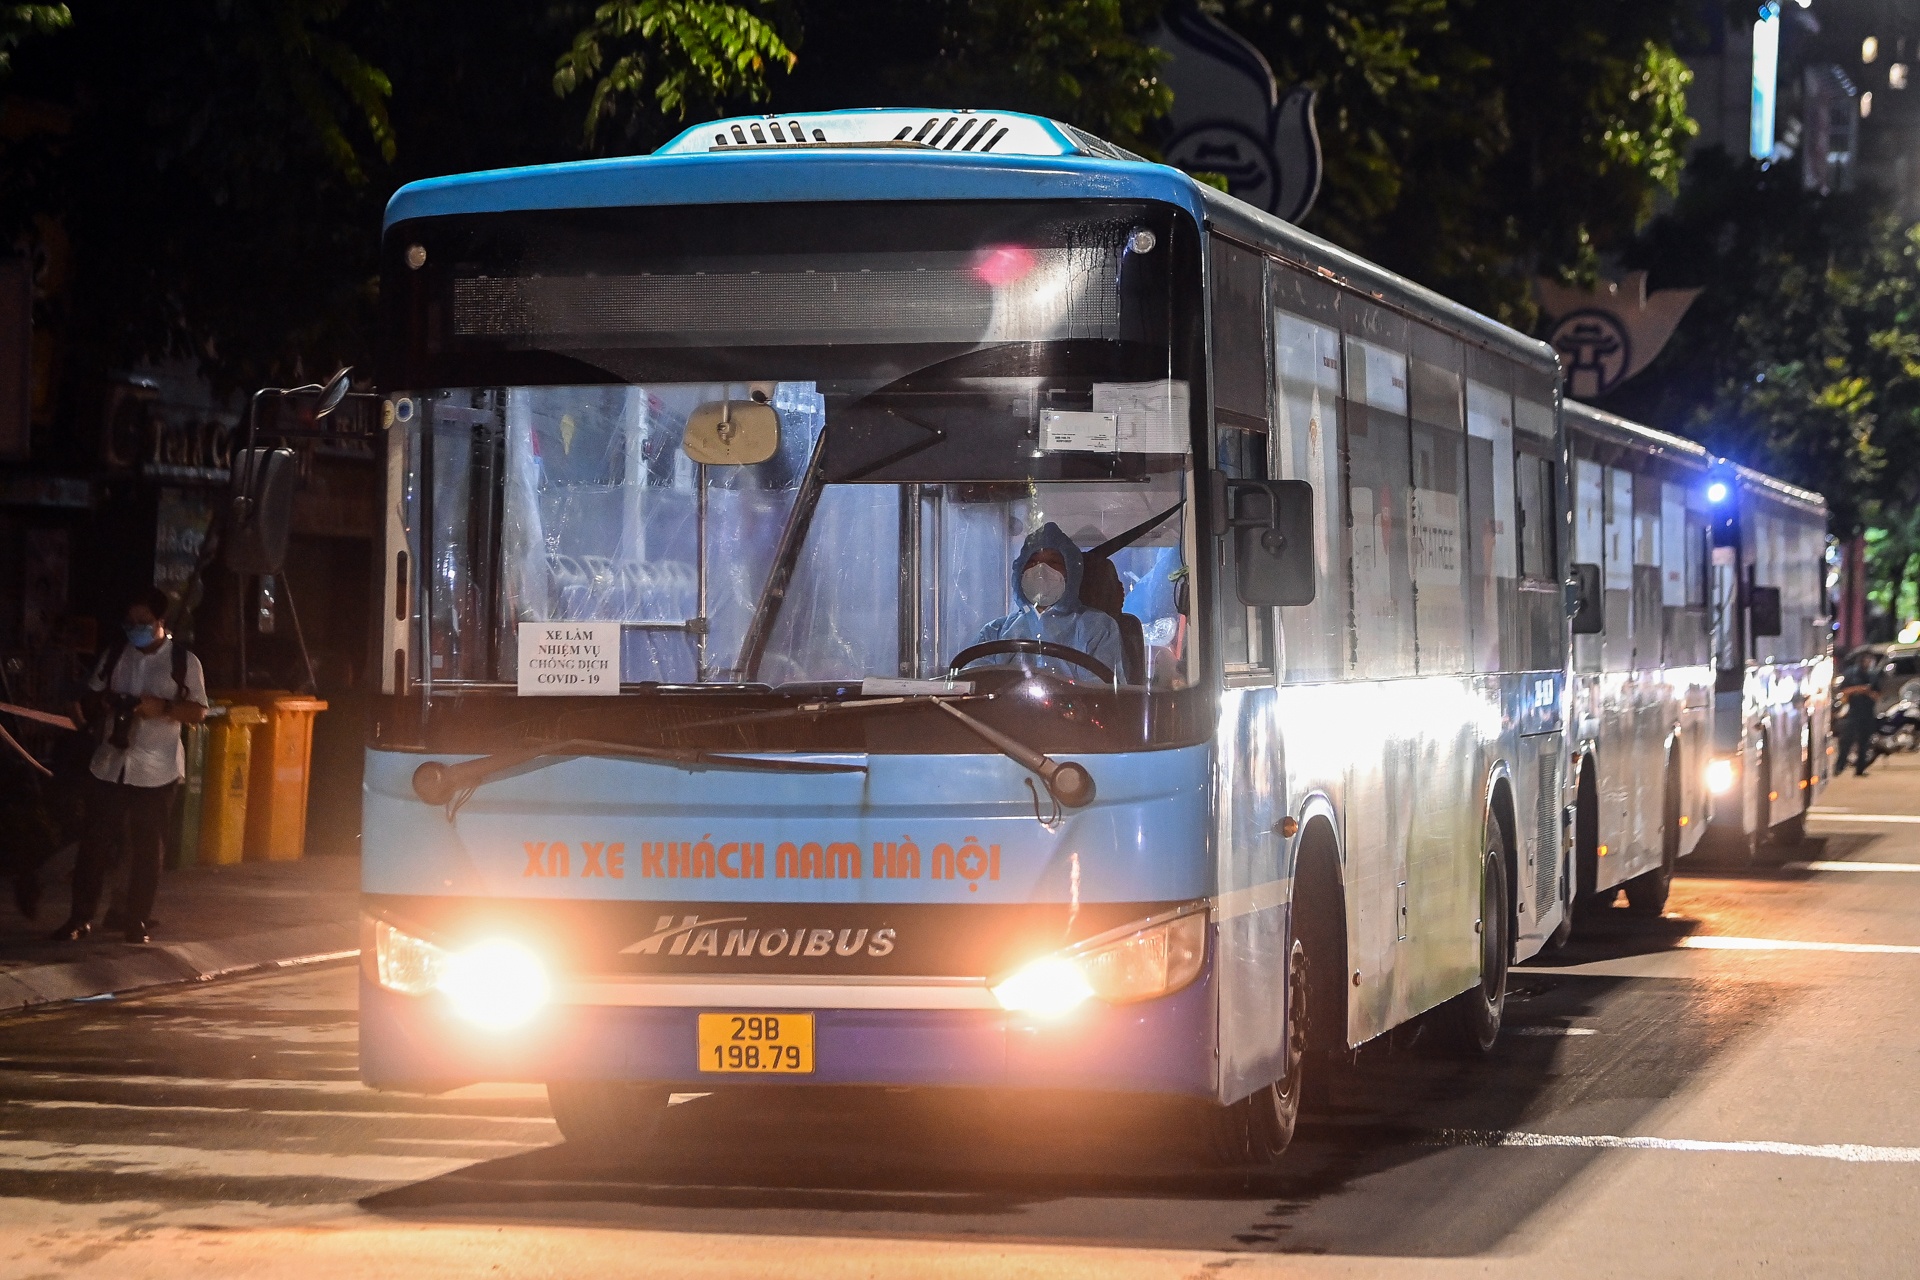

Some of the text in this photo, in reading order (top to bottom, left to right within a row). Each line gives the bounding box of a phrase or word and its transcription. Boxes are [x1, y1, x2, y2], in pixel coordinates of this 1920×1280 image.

[546, 627, 593, 641] XE LÀM
[538, 644, 601, 658] NHIỆM VỤ
[529, 657, 609, 673] CHỐNG DỊCH
[537, 674, 578, 684] COVID
[588, 674, 600, 685] 19
[580, 841, 625, 879] XE
[641, 833, 765, 879] KHÁCH
[775, 841, 862, 879] NAM
[873, 834, 921, 879] HÀ
[931, 835, 1001, 892] NỘI
[618, 915, 897, 957] HANOIBUS
[730, 1017, 780, 1041] 29B
[714, 1045, 801, 1070] 198.79
